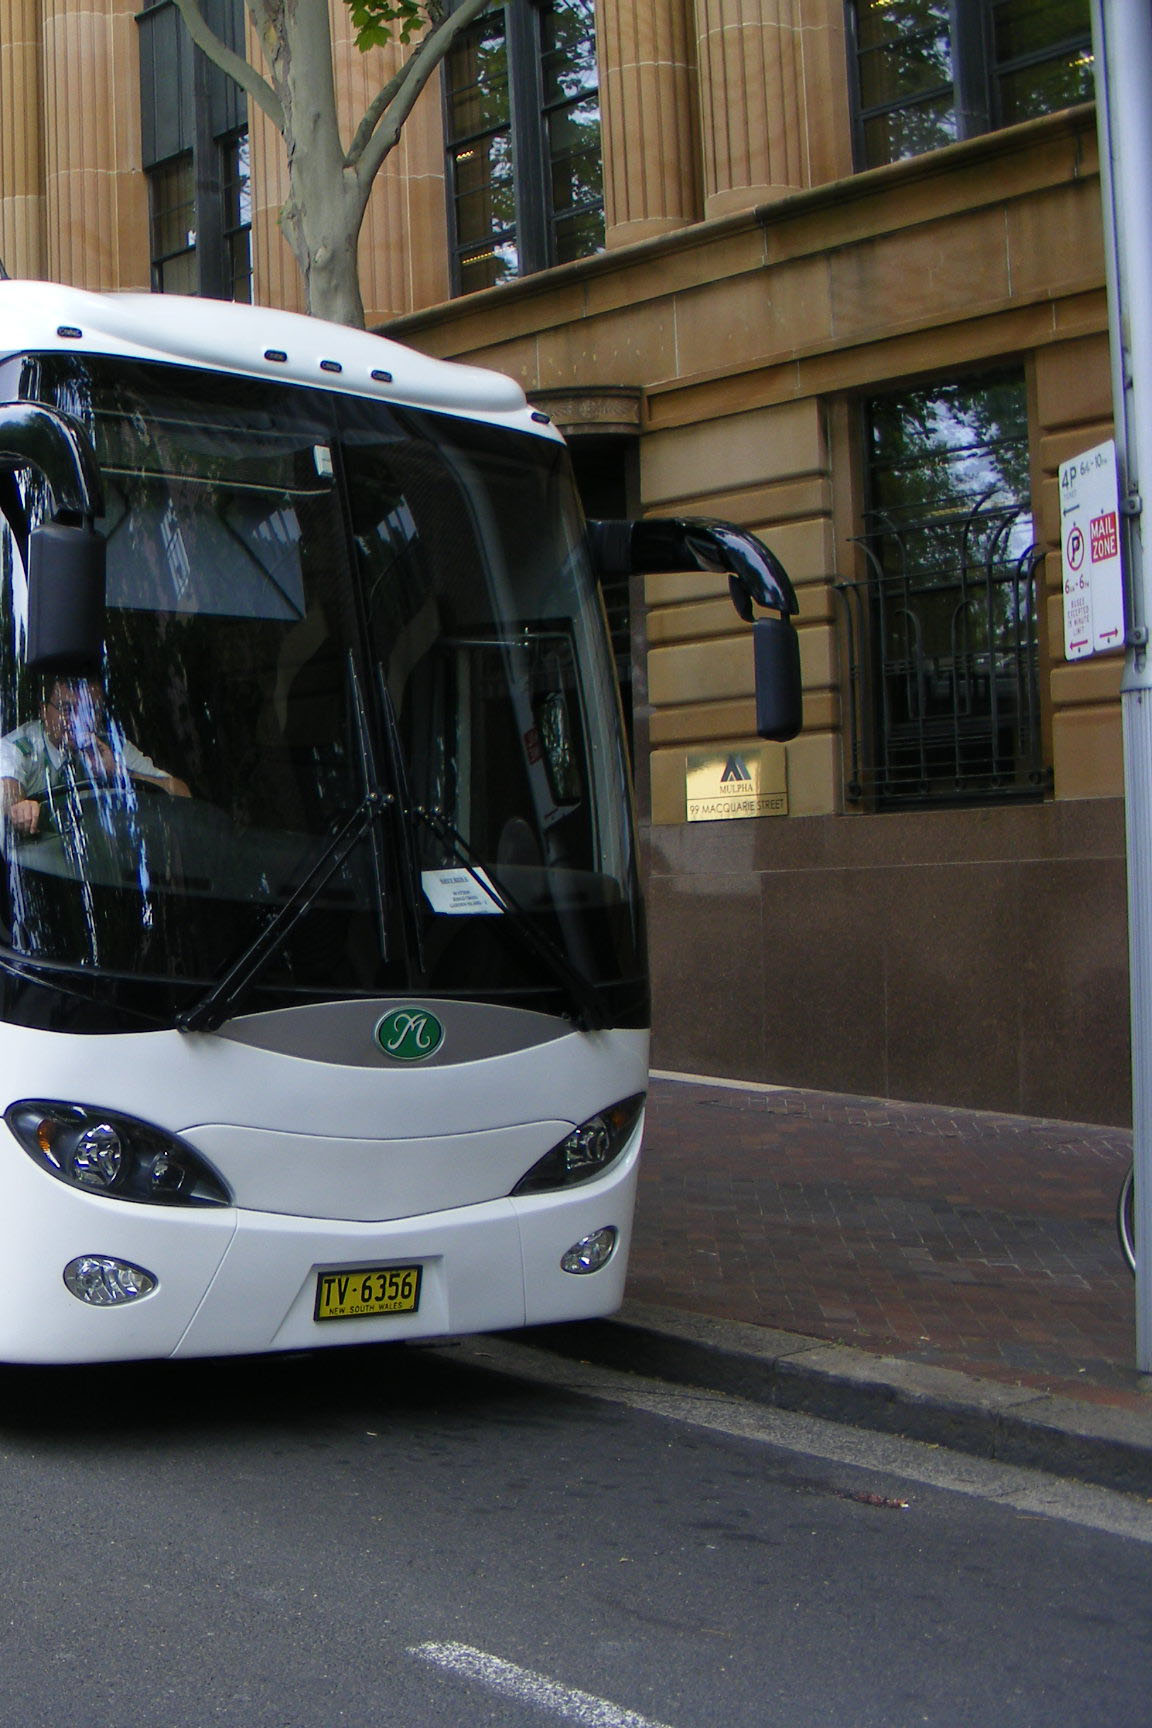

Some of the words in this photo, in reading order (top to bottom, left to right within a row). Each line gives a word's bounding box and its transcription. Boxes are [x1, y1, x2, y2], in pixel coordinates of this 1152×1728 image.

[1061, 465, 1077, 490] 4P
[1091, 516, 1115, 541] MAIL
[1092, 535, 1117, 561] ZONE
[719, 783, 753, 795] MULPHA
[689, 804, 700, 815] 99
[701, 800, 755, 814] MACQUARIE
[756, 798, 784, 811] STREET
[328, 1306, 346, 1315] NEW
[349, 1304, 375, 1314] SOUTH
[378, 1301, 403, 1311] WALES
